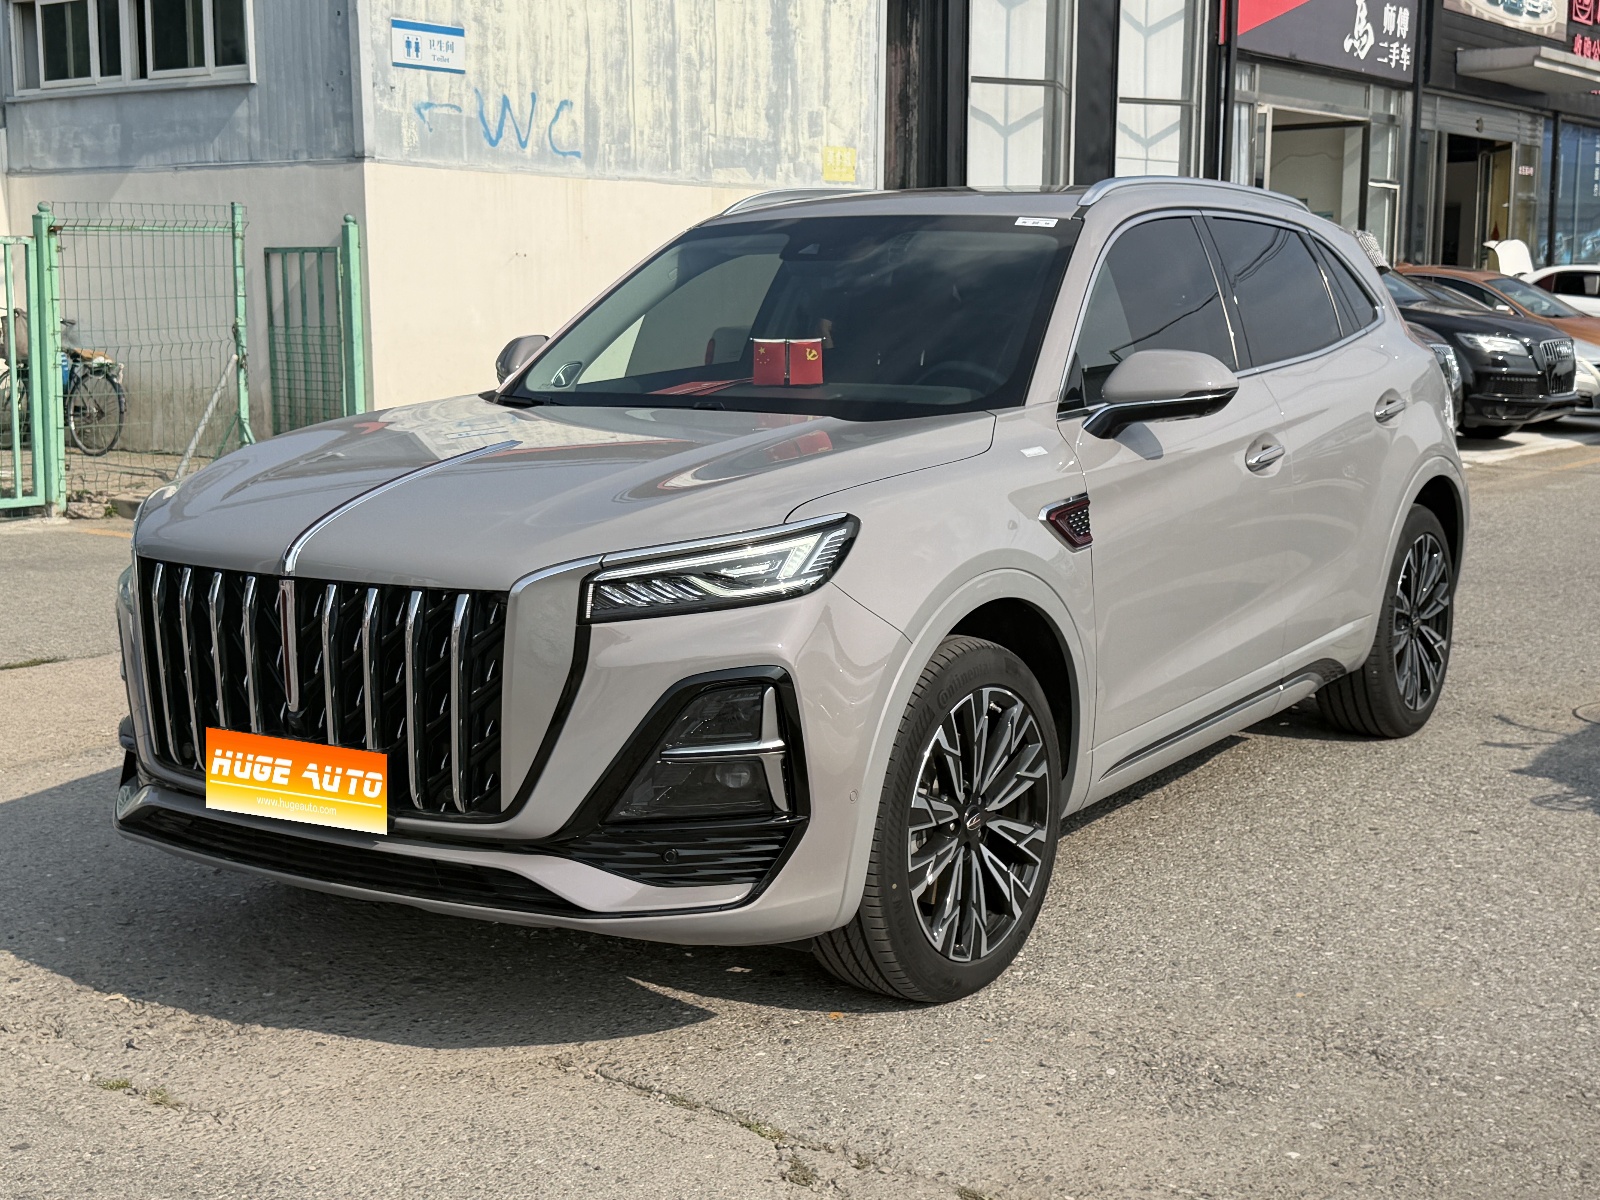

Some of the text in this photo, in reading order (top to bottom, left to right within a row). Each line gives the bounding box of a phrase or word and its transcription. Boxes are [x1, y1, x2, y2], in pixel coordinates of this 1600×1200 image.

[429, 39, 455, 53] 卫生间
[1377, 41, 1411, 71] 二手车
[432, 54, 450, 63] Toilet
[474, 87, 582, 159] WC
